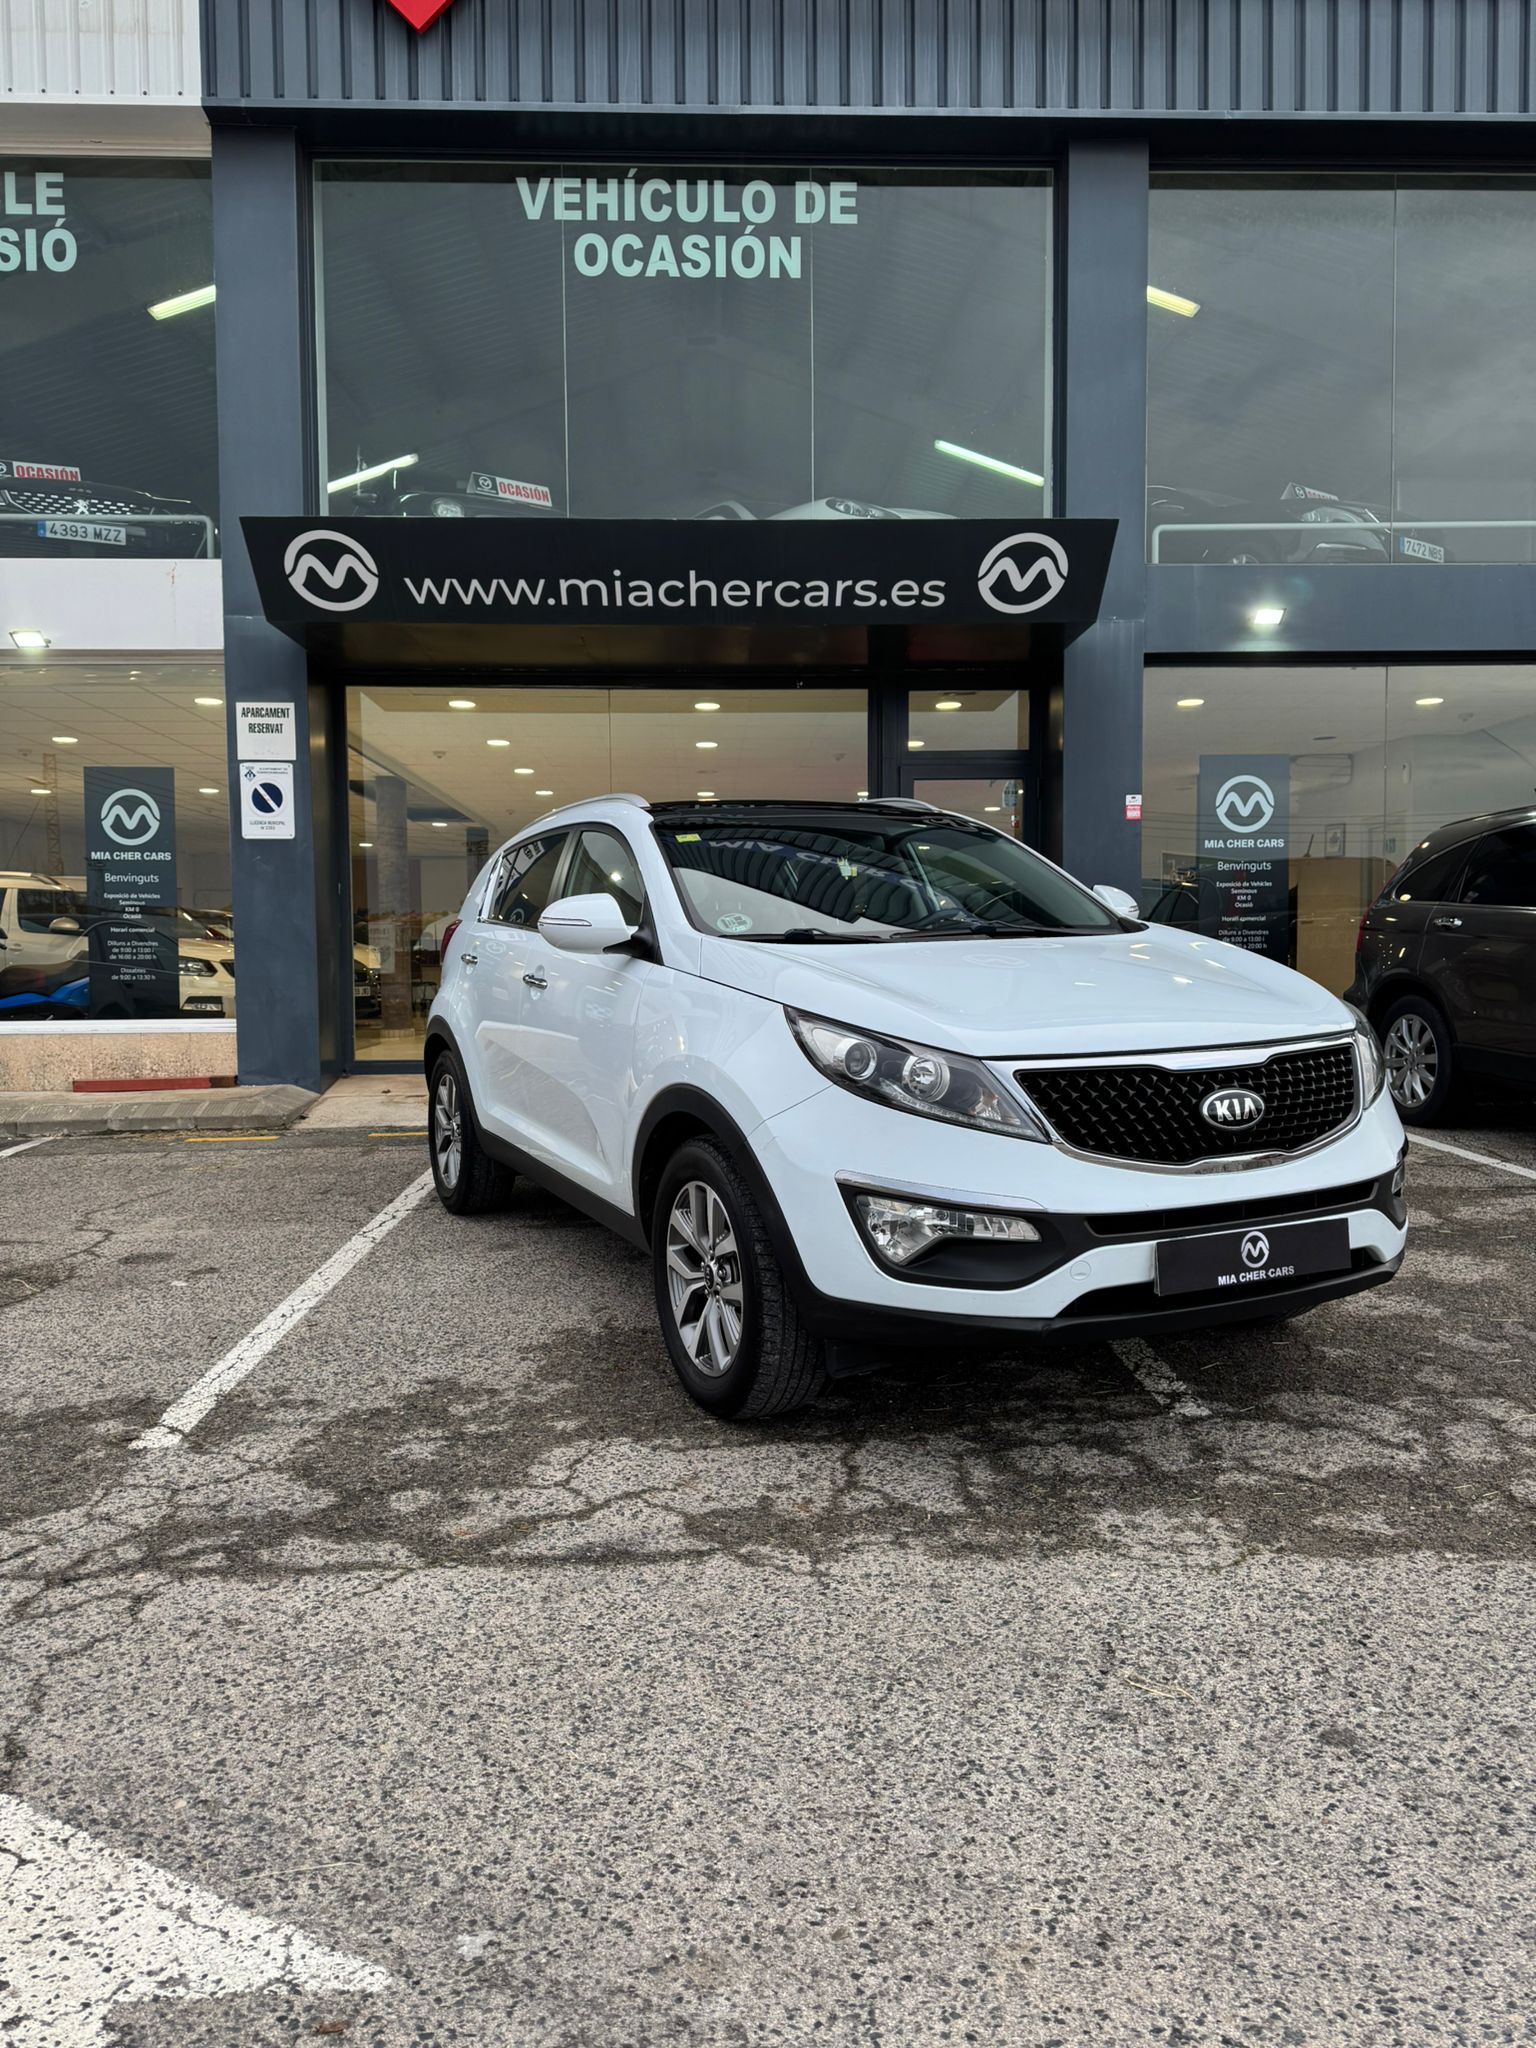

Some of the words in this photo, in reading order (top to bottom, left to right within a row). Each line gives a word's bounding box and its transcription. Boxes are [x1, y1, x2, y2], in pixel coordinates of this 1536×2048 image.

[515, 168, 776, 224] VEHÍCULO
[795, 181, 859, 225] DE
[574, 225, 802, 279] OCASIÓN
[15, 465, 79, 481] OCASIÓN
[499, 481, 550, 503] OCASIÓN
[49, 522, 88, 539] 4393
[93, 527, 122, 543] MZZ
[403, 569, 947, 608] www.miachercars.es
[241, 707, 290, 718] APARCAMENT
[248, 722, 283, 734] RESERVAT
[1204, 840, 1225, 848] MIA
[1226, 839, 1254, 848] CHER
[1256, 839, 1285, 848] CARS
[91, 852, 112, 860] MIA
[113, 852, 141, 860] CHER
[143, 852, 172, 860] CARS
[1217, 861, 1272, 873] Benvinguts
[104, 873, 159, 885] Benvinguts
[1214, 1097, 1259, 1122] KIA
[1218, 1274, 1237, 1286] MIA
[1239, 1270, 1267, 1282] CHER
[1268, 1265, 1295, 1278] CARS
